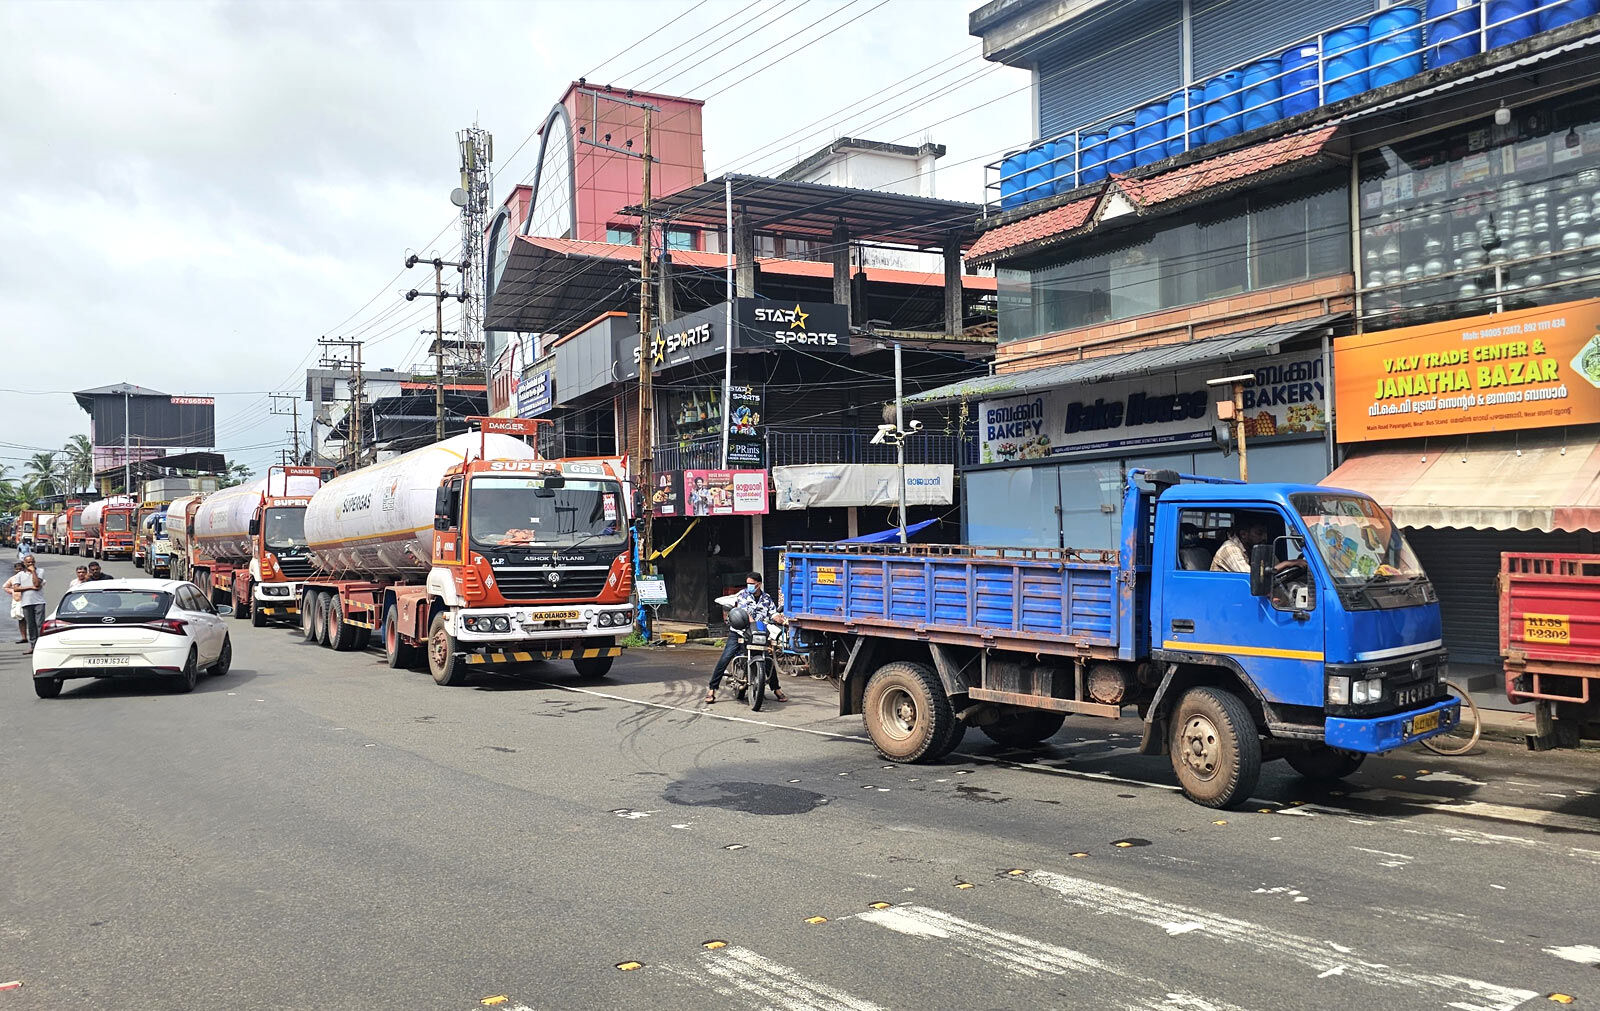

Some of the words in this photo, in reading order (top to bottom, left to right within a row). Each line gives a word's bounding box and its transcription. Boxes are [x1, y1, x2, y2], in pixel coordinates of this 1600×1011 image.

[755, 308, 796, 323] STAR
[666, 323, 710, 353] SPORTS
[775, 330, 838, 346] SPORTS
[1383, 354, 1420, 373] V.K.V
[1423, 348, 1470, 369] TRADE
[1472, 341, 1529, 362] CENTER
[1532, 338, 1546, 354] &
[1374, 369, 1472, 400] JANATHA
[1477, 358, 1560, 388] BAZAR
[1477, 395, 1485, 406] &
[490, 462, 557, 471] SUPER
[570, 464, 598, 473] Gas
[342, 493, 372, 514] SUPERGAS
